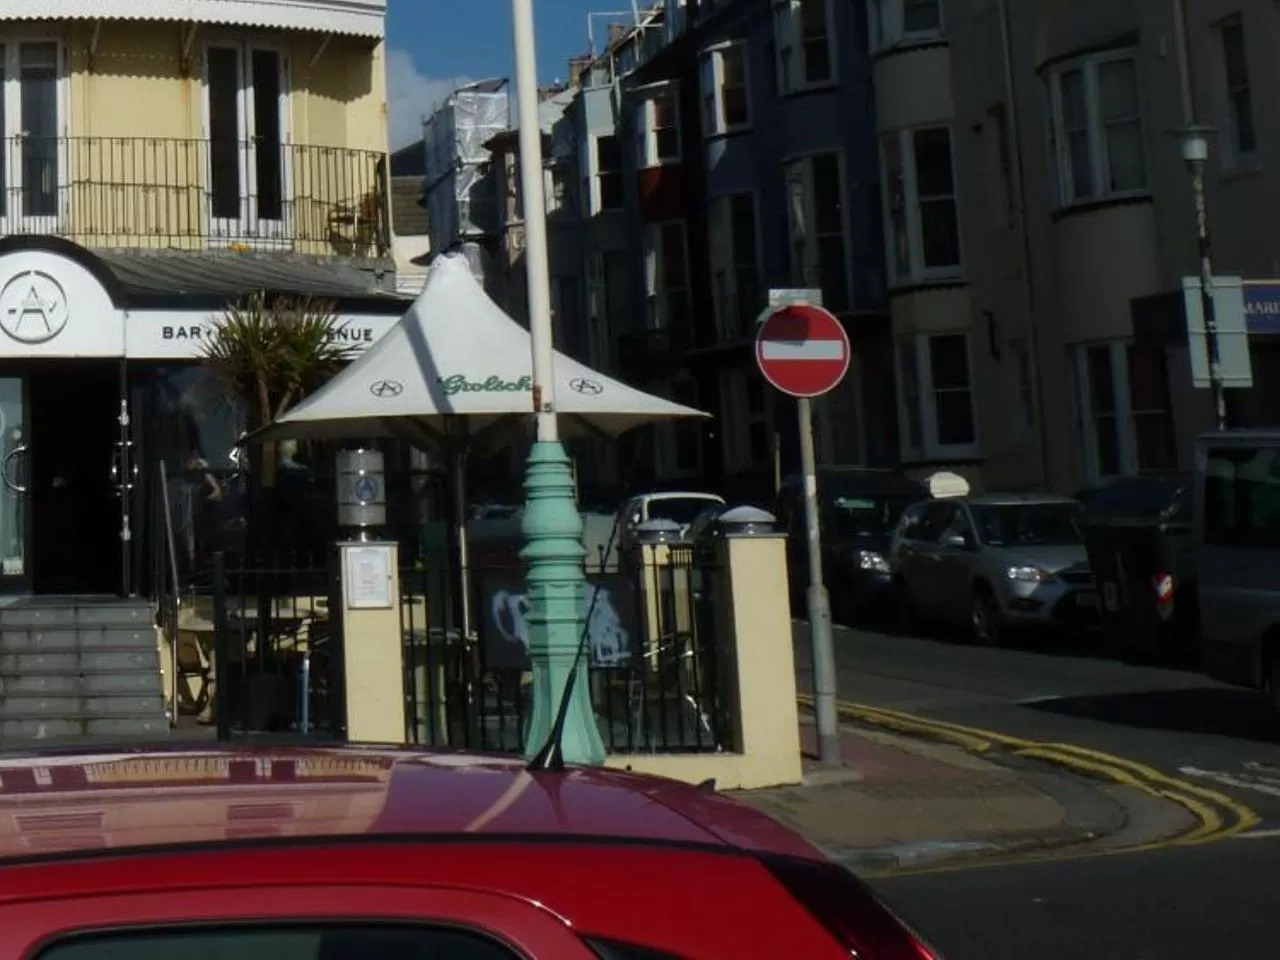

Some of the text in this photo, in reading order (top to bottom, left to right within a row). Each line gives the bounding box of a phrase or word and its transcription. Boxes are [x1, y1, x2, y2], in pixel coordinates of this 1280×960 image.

[163, 326, 201, 340] BAR
[328, 328, 373, 342] ENUE
[438, 374, 534, 395] Grolsch
